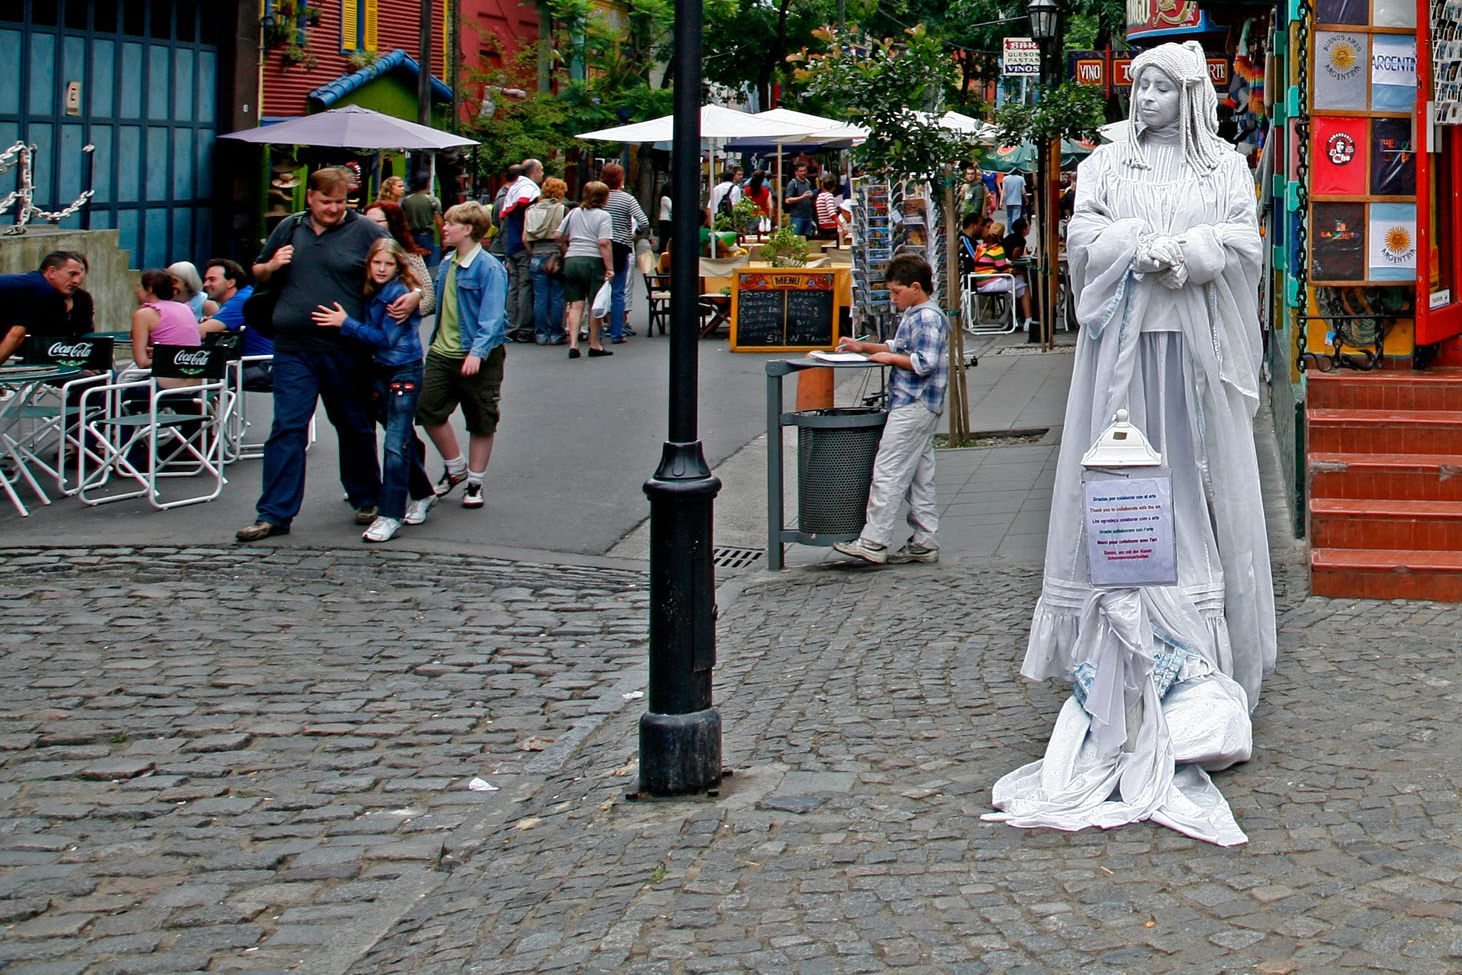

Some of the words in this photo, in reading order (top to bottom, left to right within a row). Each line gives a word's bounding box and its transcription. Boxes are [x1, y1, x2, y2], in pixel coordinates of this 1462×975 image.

[1007, 65, 1040, 73] VINOS
[1080, 65, 1101, 81] VINO
[775, 276, 800, 285] MENU
[48, 342, 94, 358] Coca-Cola
[174, 349, 212, 366] Coca-Cola
